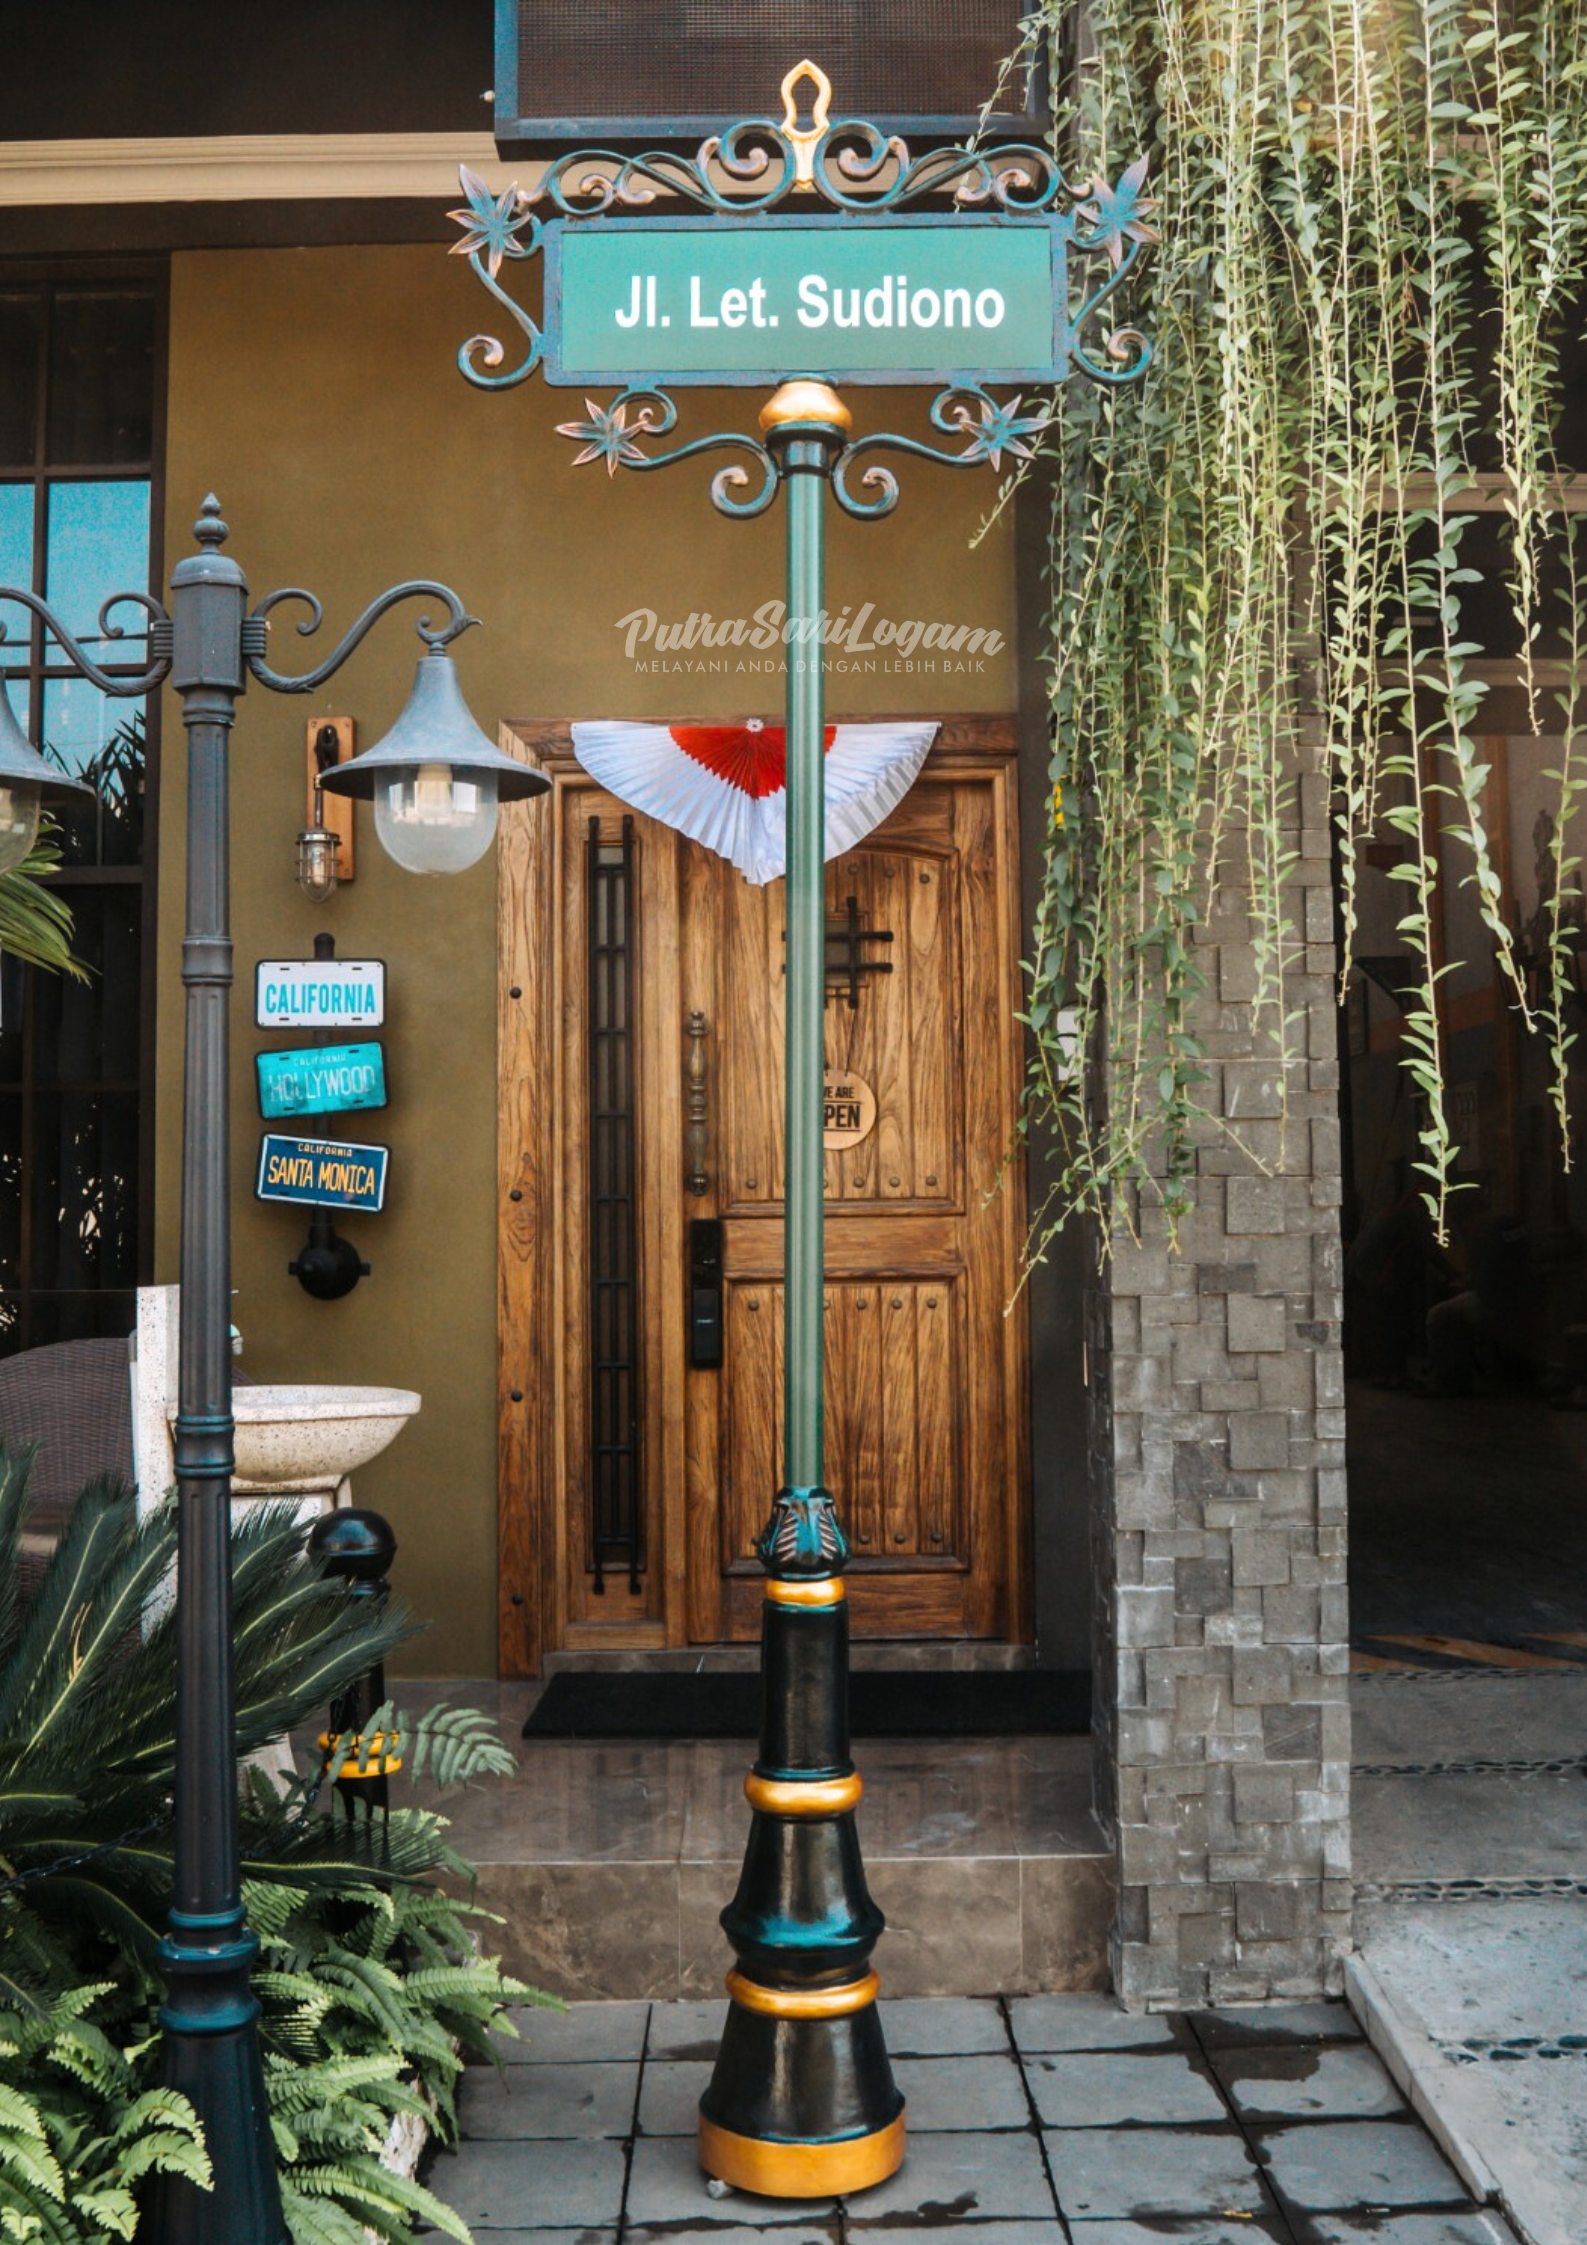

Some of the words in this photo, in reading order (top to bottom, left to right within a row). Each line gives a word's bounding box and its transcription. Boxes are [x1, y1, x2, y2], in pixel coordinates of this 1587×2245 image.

[615, 275, 670, 328] Jl.
[690, 275, 779, 328] Let.
[797, 274, 1006, 329] Sudiono
[265, 983, 376, 1014] CALIFORNIA
[293, 1053, 347, 1067] CALIFORNIA
[268, 1065, 376, 1102] HOLLYWOOD
[836, 1086, 855, 1099] ARE
[824, 1104, 860, 1128] PEN
[298, 1143, 353, 1158] CALIFORNIA
[268, 1155, 314, 1188] SANTA
[318, 1161, 375, 1196] MONICA
